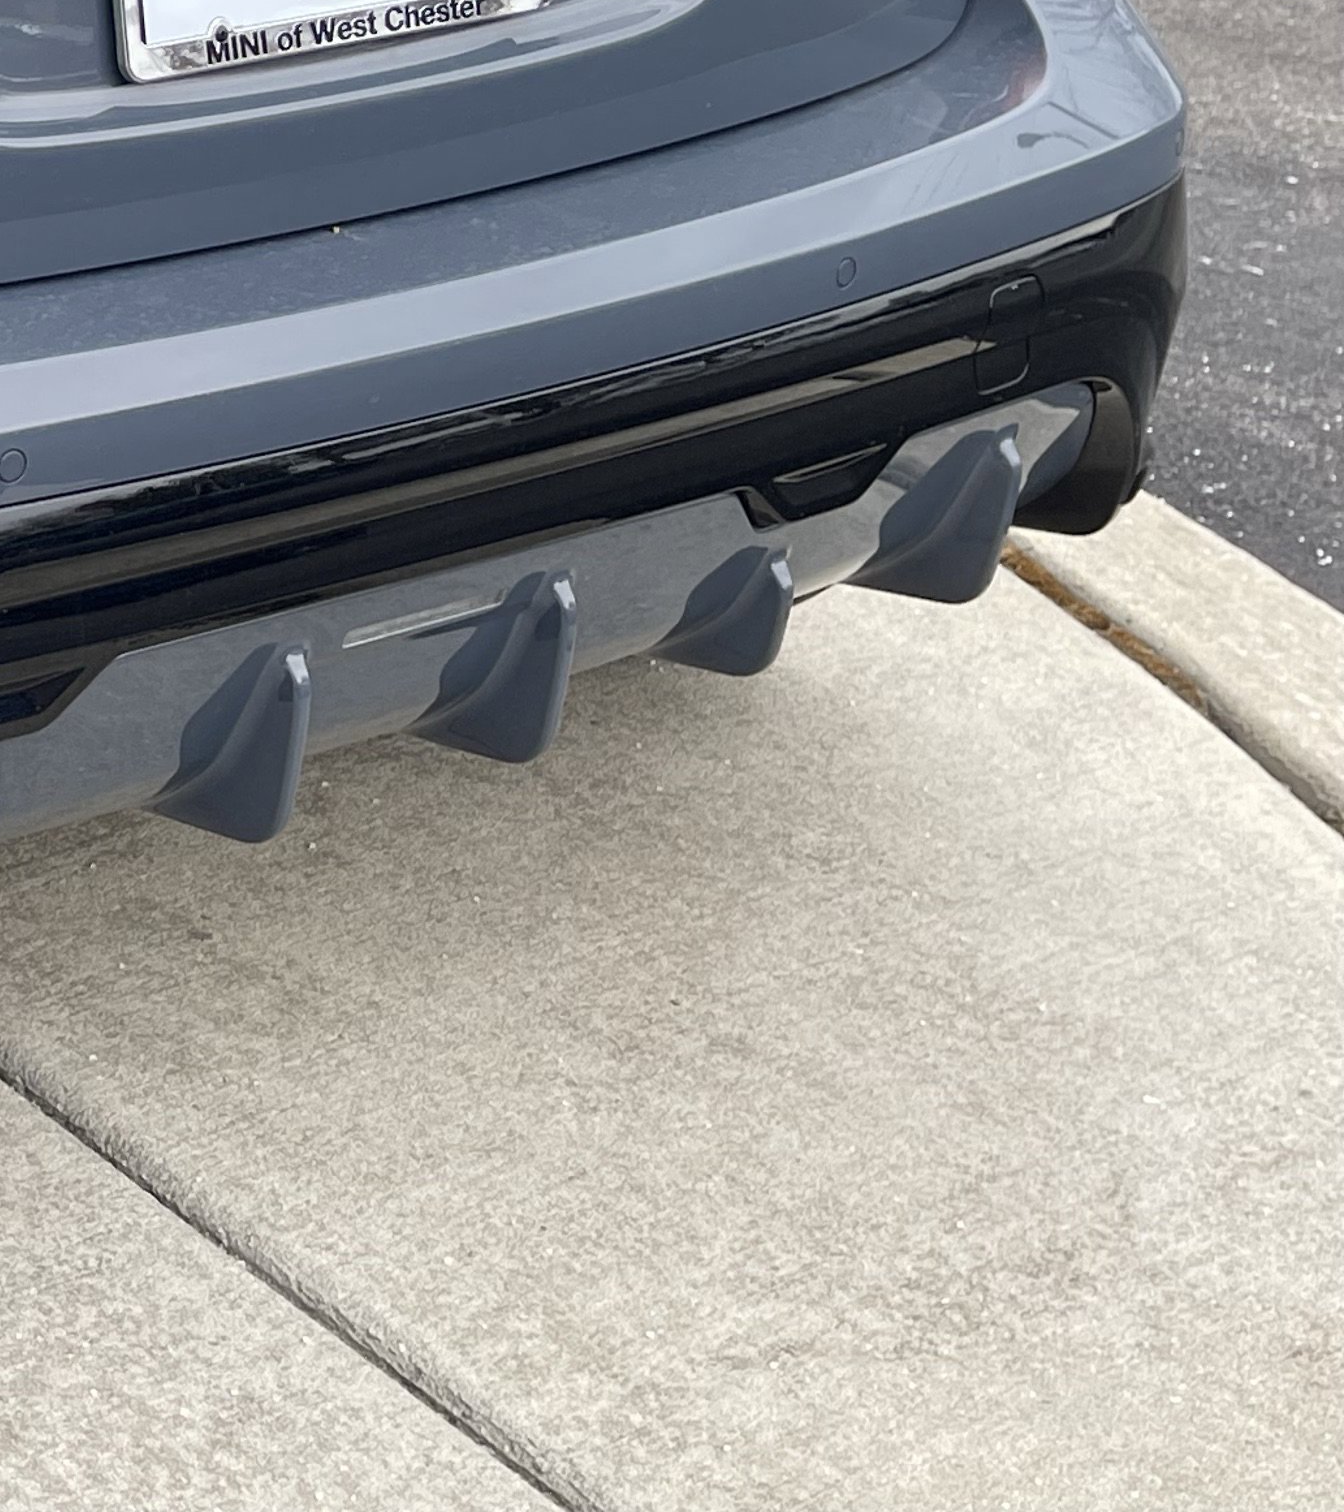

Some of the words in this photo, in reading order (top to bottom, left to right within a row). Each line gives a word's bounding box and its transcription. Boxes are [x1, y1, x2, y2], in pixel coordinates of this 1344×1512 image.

[206, 29, 269, 65] MINI
[277, 23, 303, 52] of
[311, 10, 378, 45] West
